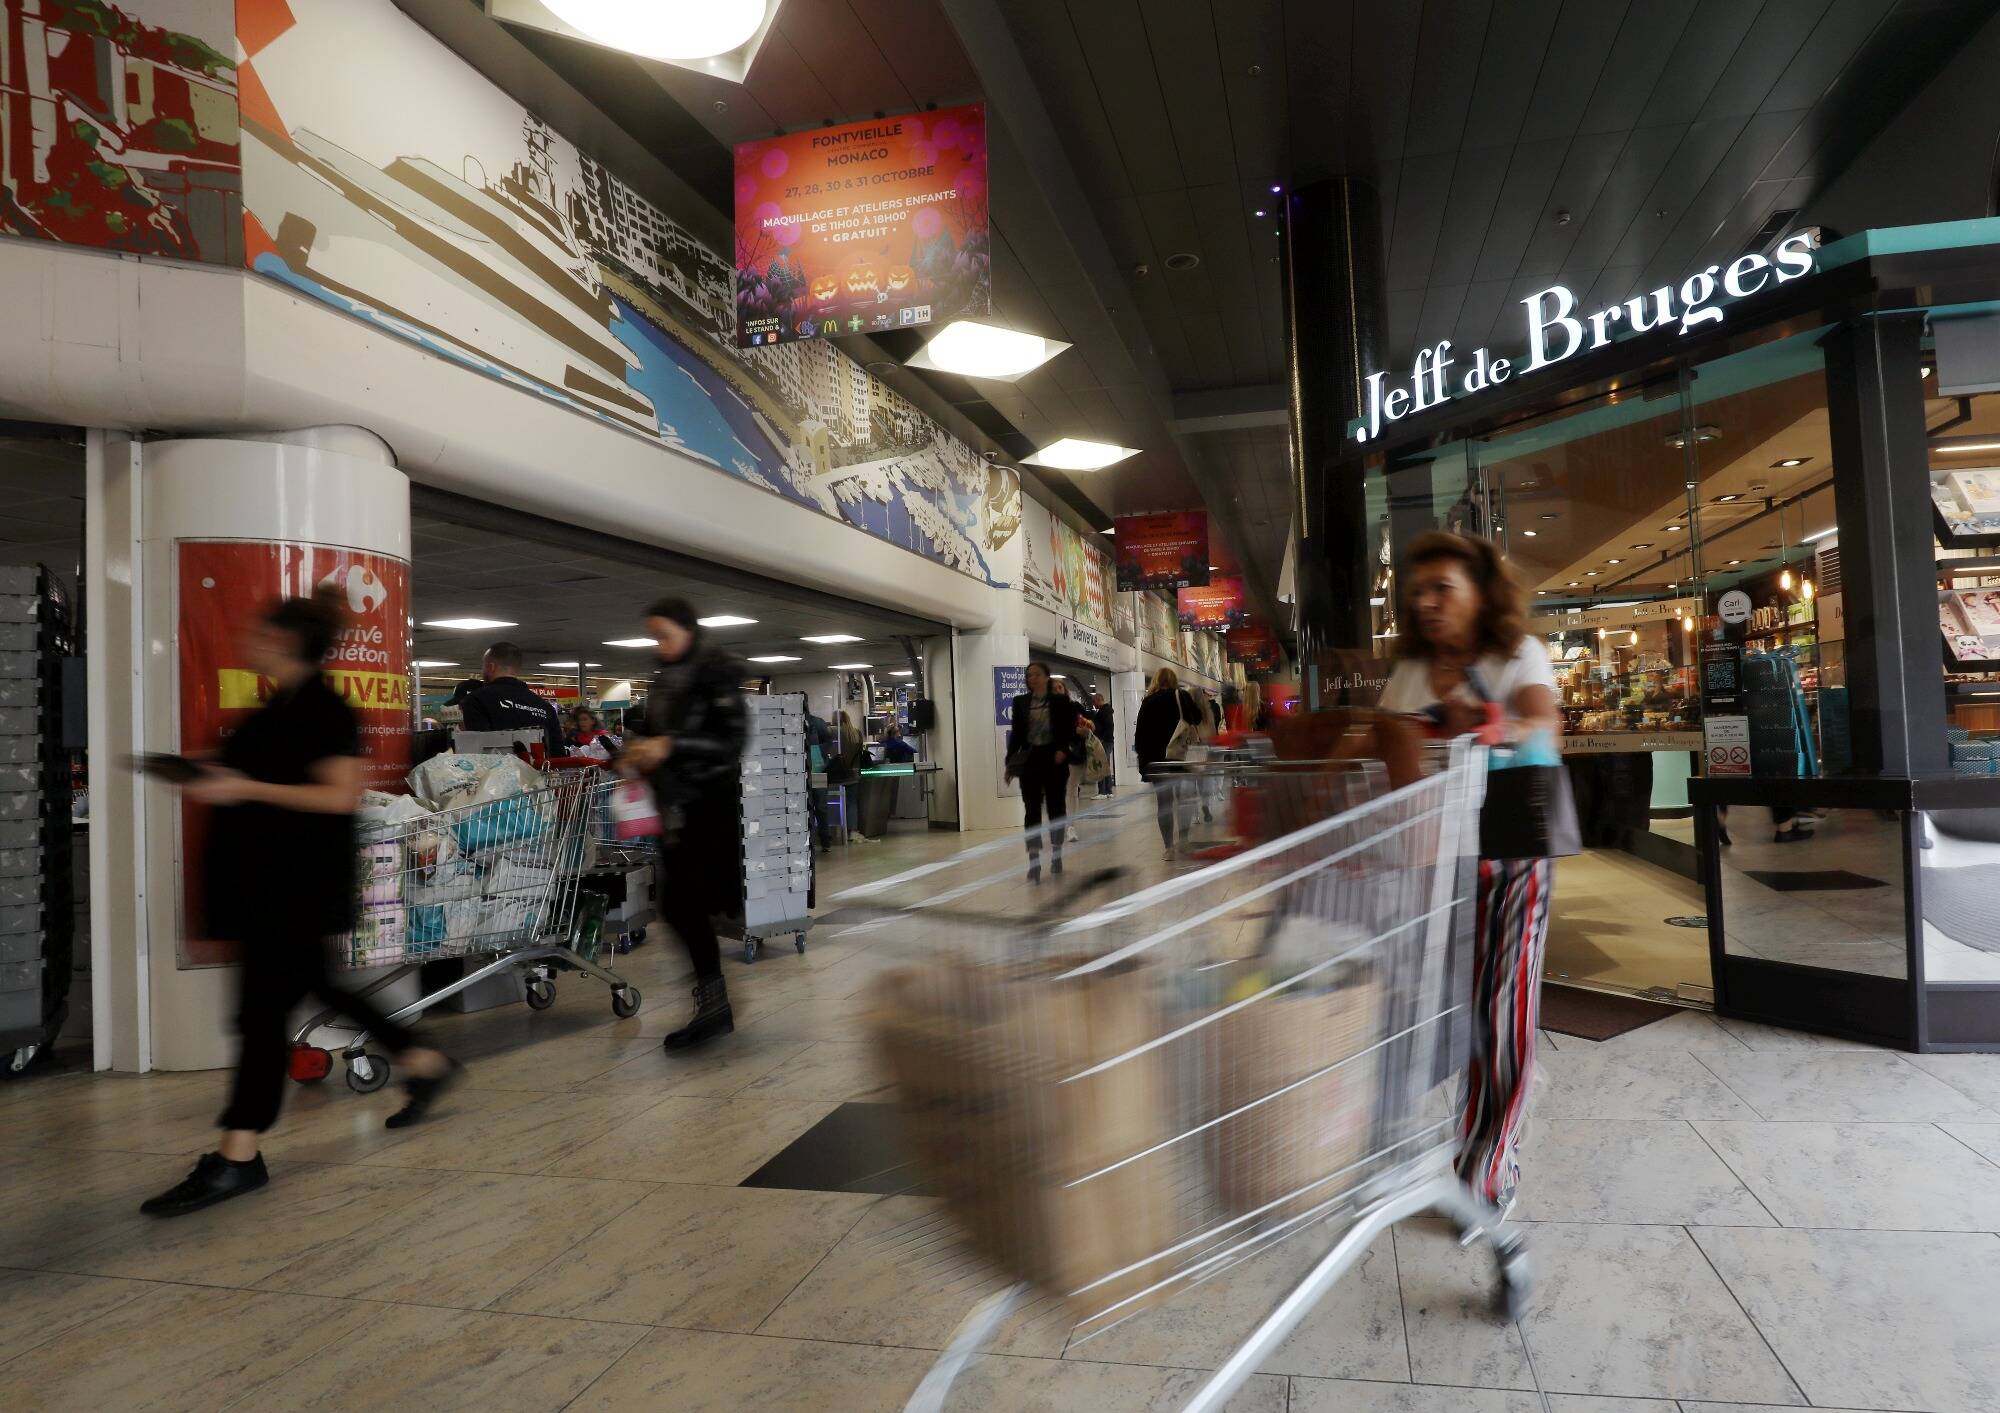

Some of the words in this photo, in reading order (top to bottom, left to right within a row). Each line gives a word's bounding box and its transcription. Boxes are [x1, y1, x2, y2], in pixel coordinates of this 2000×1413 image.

[812, 124, 903, 148] FONTVIEILLE
[827, 148, 889, 167] MONACO
[784, 186, 801, 199] 27,
[826, 180, 841, 192] 30
[845, 178, 854, 189] &
[856, 176, 868, 188] 31
[871, 165, 935, 185] OCTOBRE
[763, 209, 834, 228] MAQUILLAGE
[836, 206, 850, 217] ET
[852, 198, 903, 215] ATELIERS
[905, 189, 957, 207] ENFANTS
[811, 223, 827, 234] DE
[829, 218, 860, 231] 11H00
[832, 227, 889, 243] GRATUIT
[753, 325, 774, 333] STAND
[766, 317, 780, 325] SUR
[1355, 340, 1455, 443] Jeff
[1463, 347, 1512, 393] de
[1518, 232, 1815, 375] Bruges
[334, 625, 383, 644] rive
[321, 642, 391, 665] piéton
[257, 674, 410, 704] NUVEA
[1324, 675, 1342, 693] Jeff
[1343, 680, 1352, 689] de
[1352, 672, 1393, 691] Bruges
[356, 724, 396, 736] principe
